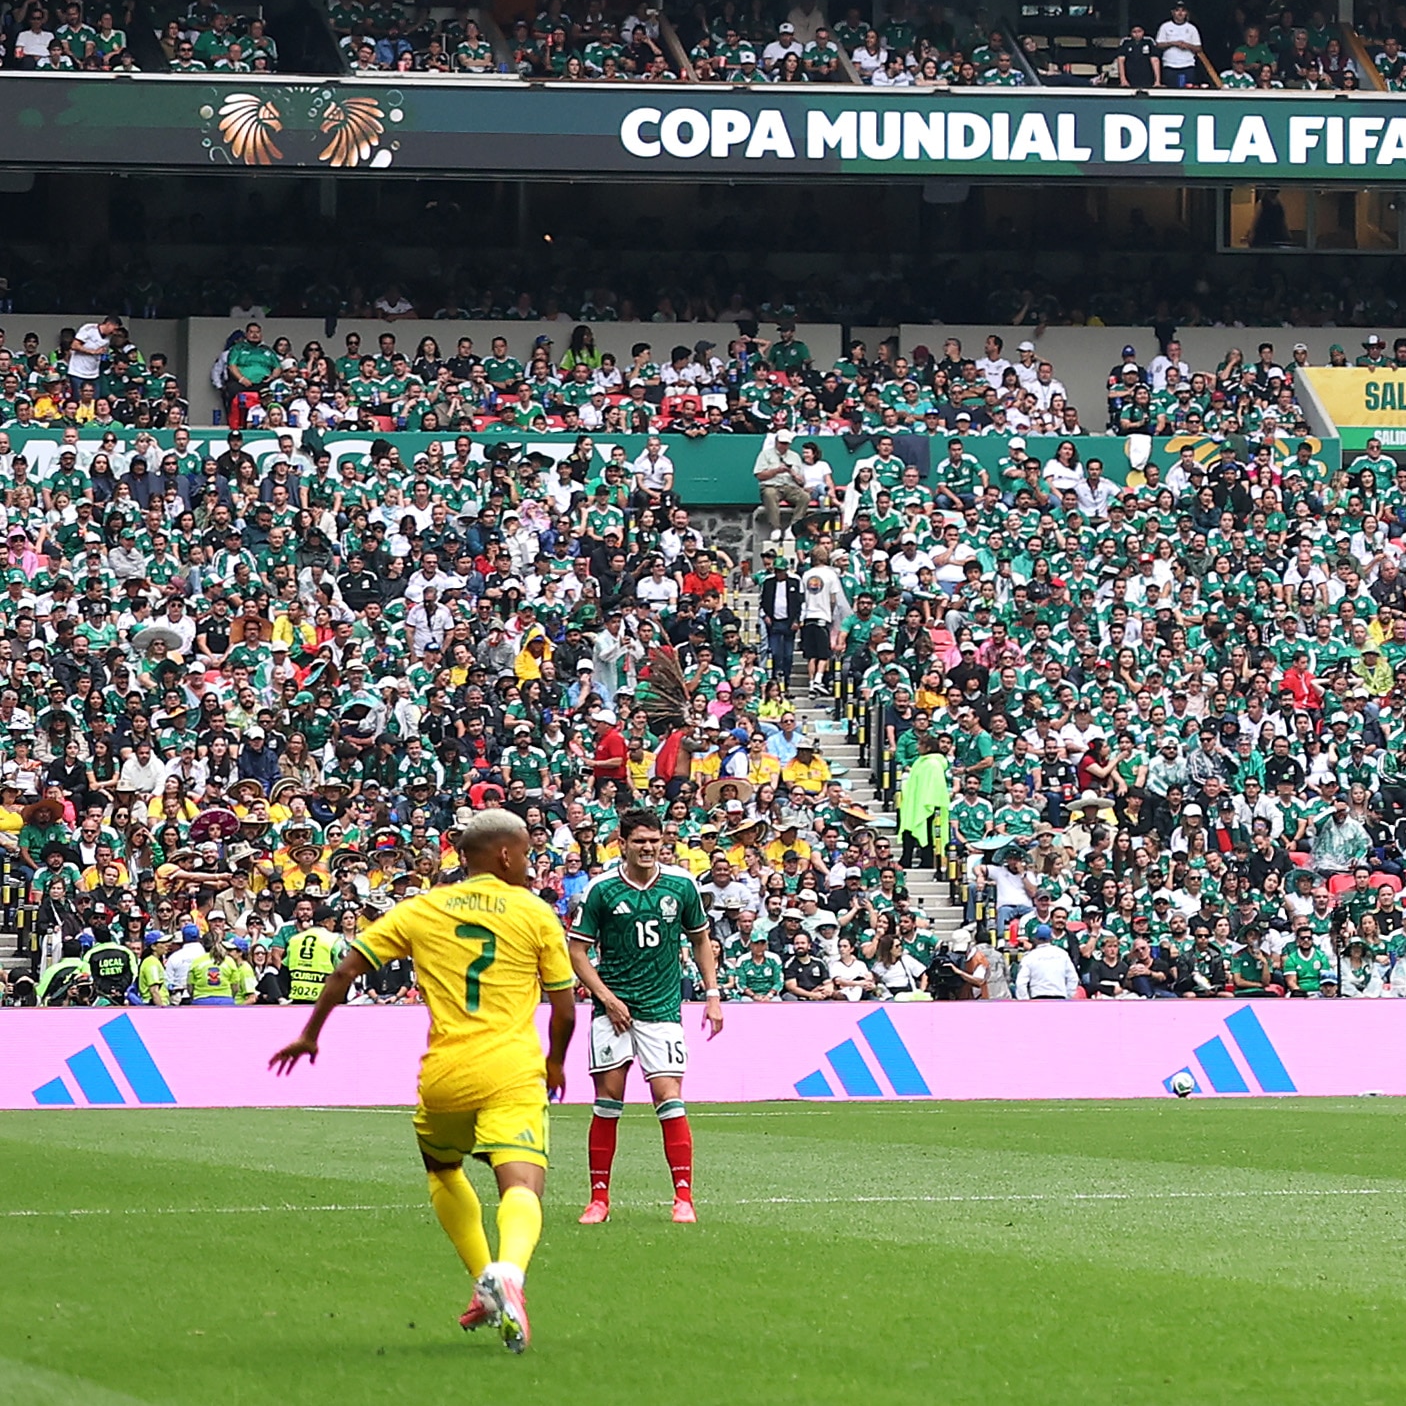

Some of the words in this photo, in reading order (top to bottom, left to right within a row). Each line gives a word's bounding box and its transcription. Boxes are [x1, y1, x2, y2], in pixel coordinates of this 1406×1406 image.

[620, 107, 796, 158] COPA
[807, 110, 1092, 162] MUNDIAL
[1104, 113, 1185, 162] DE
[1197, 115, 1278, 163] LA
[635, 919, 661, 948] 15
[99, 957, 125, 968] LOCAL
[99, 966, 124, 976] CREW
[454, 923, 496, 1013] 7
[665, 1040, 685, 1065] 15
